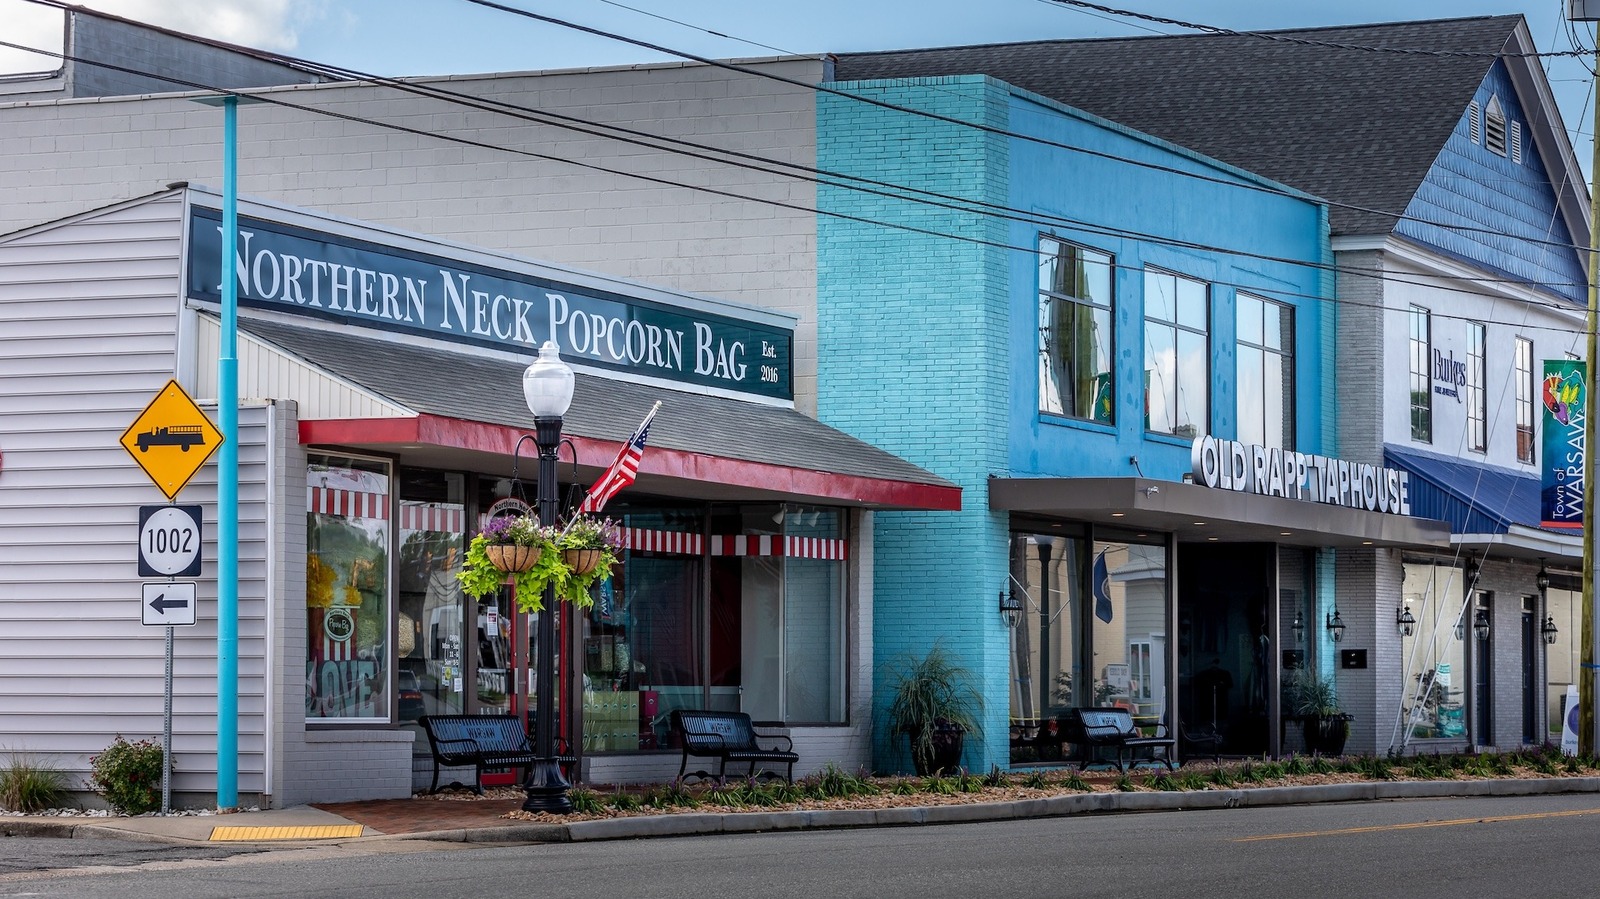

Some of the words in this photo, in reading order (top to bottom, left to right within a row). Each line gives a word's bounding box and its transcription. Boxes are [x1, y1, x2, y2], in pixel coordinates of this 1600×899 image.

[217, 226, 428, 326] NORTHERN
[440, 269, 537, 344] NECK
[545, 293, 684, 372] POPCORN
[694, 321, 747, 382] BAG
[761, 340, 777, 359] Est.
[761, 365, 778, 384] 2016
[1434, 348, 1466, 404] Burkes
[1192, 434, 1247, 492] OLD
[1252, 444, 1307, 500] RAPP
[1308, 454, 1411, 516] TAPHOUSE
[1553, 467, 1565, 481] of
[1565, 411, 1585, 519] WARSAW
[1552, 485, 1565, 519] Town
[148, 528, 192, 553] 1002
